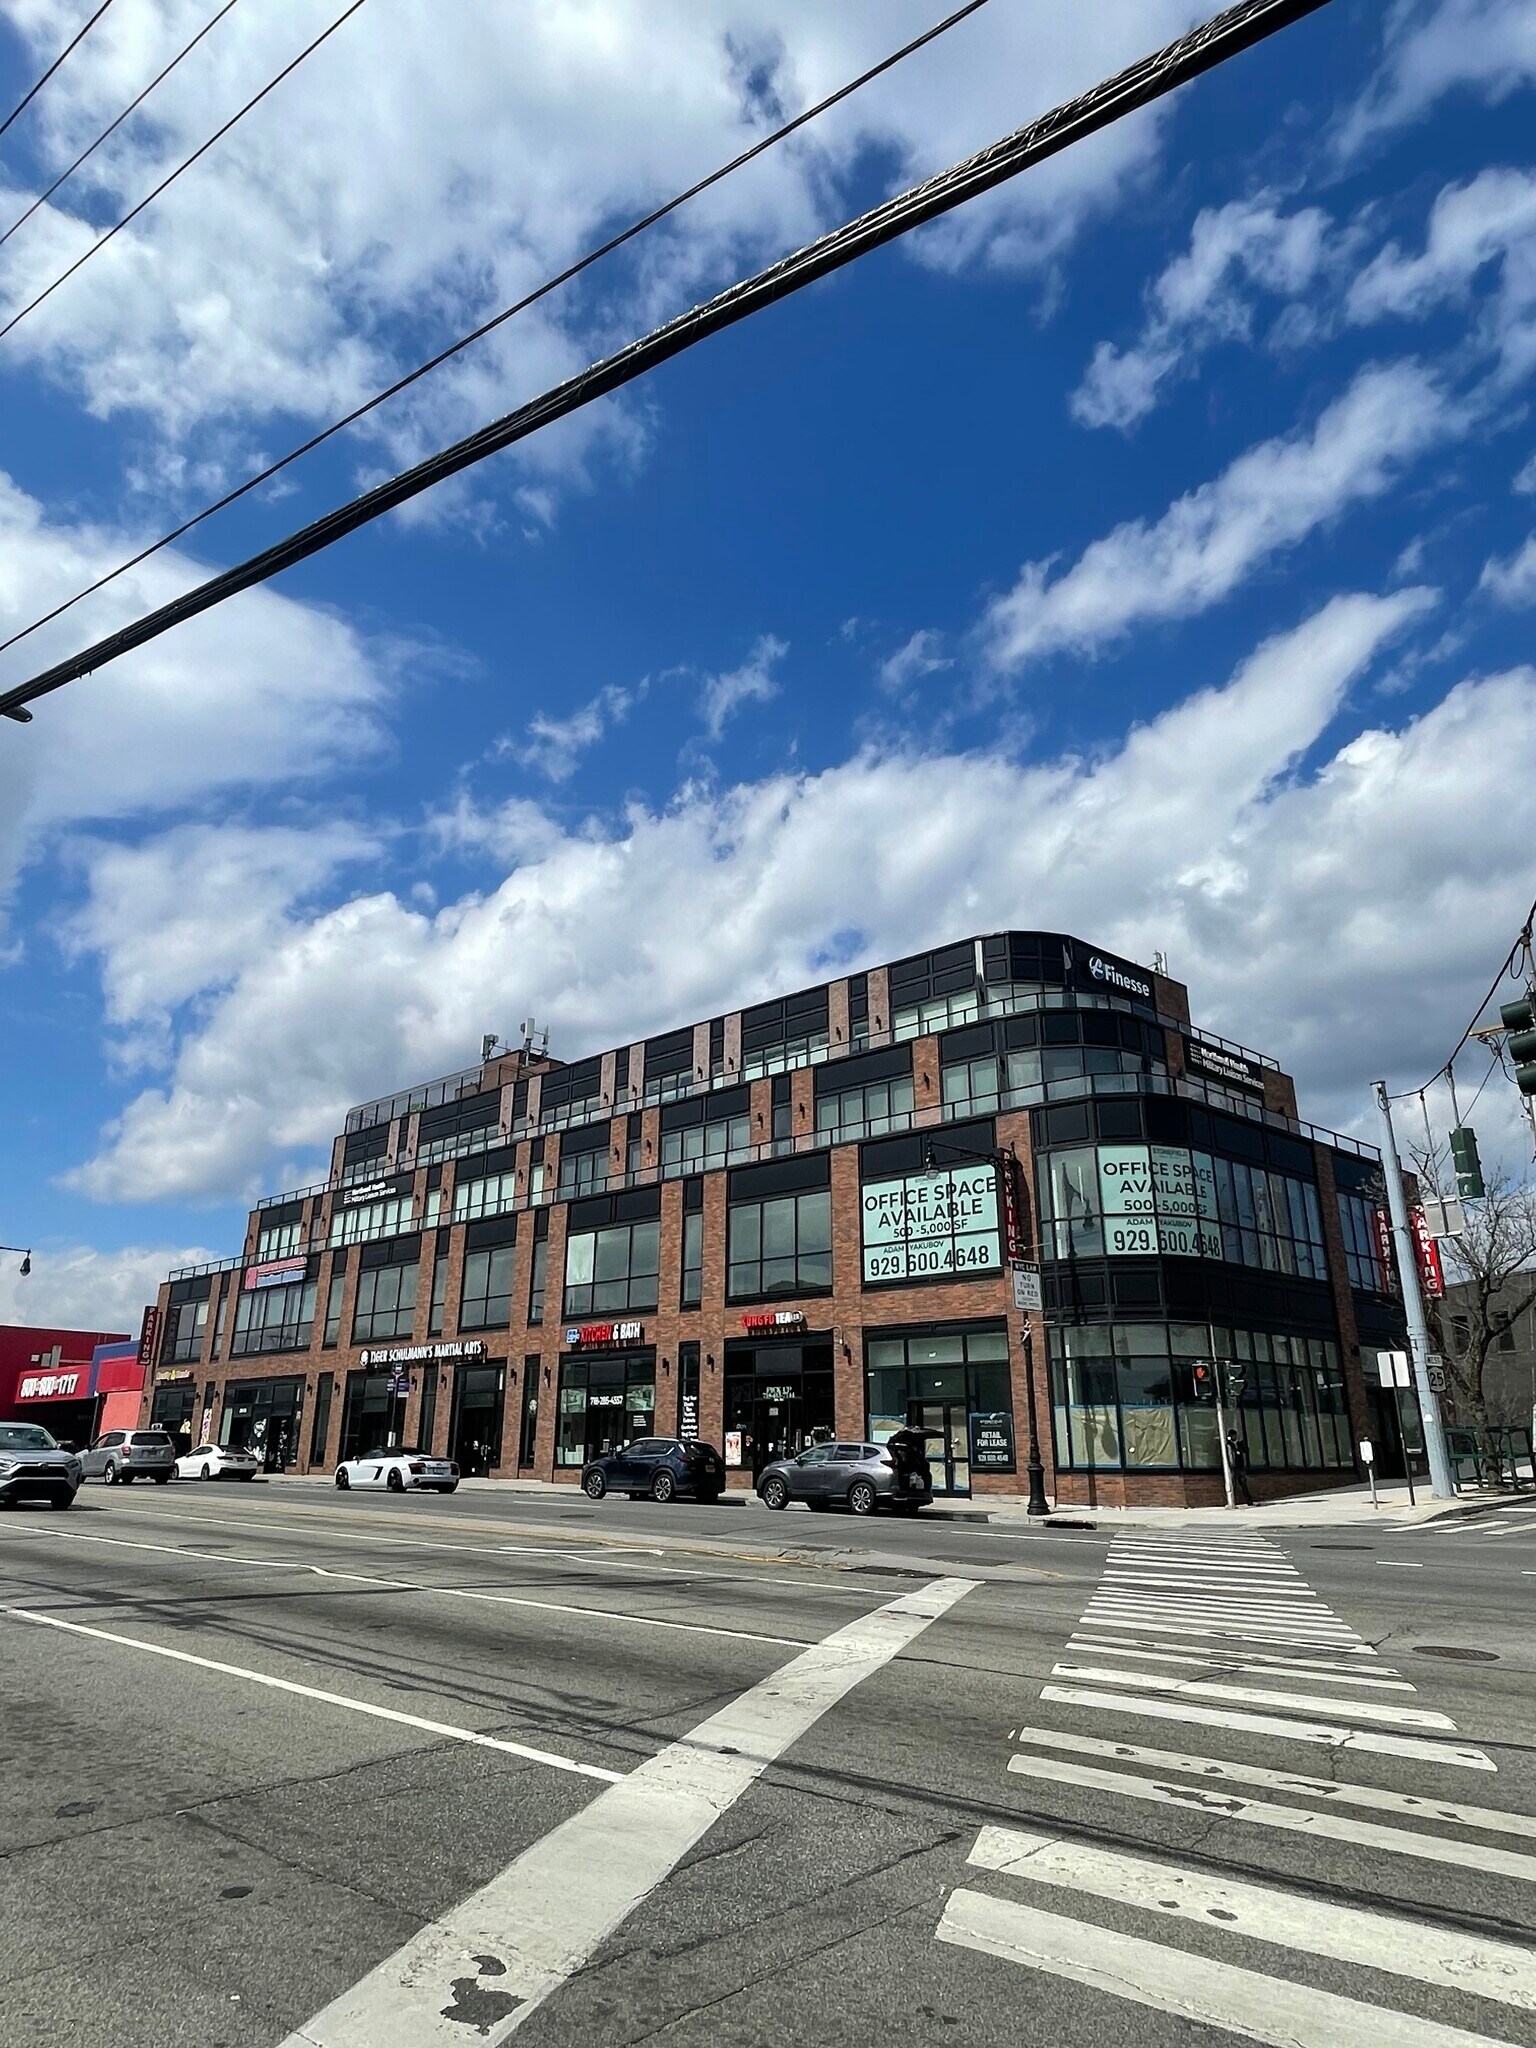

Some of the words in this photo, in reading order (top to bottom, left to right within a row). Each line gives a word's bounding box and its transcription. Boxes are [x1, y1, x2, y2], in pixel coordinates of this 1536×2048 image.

[1104, 964, 1150, 997] Finesse
[1203, 1058, 1222, 1076] Military
[1223, 1067, 1243, 1081] Liaison
[1242, 1074, 1265, 1090] Services
[1103, 1162, 1170, 1176] OFFICE
[1172, 1164, 1213, 1183] SPACE
[864, 1187, 928, 1211] OFFICE
[933, 1176, 997, 1201] SPACE
[1120, 1179, 1207, 1199] AVAILABLE
[878, 1198, 983, 1229] AVAILABLE
[1124, 1199, 1153, 1211] 500
[893, 1226, 913, 1239] 500
[954, 1218, 968, 1230] SF
[1126, 1218, 1153, 1226] ADAM
[883, 1245, 905, 1255] ADAM
[909, 1240, 945, 1251] YAKUBOV
[1113, 1229, 1219, 1257] 929.600.4648
[870, 1245, 989, 1277] 929.600.4648
[1014, 1262, 1026, 1271] NYC
[1019, 1281, 1035, 1290] TURN
[1022, 1274, 1032, 1282] NO
[1016, 1288, 1025, 1296] ON
[1027, 1289, 1039, 1298] RED
[775, 1311, 792, 1325] TEA
[142, 1307, 156, 1359] PARKING
[581, 1324, 612, 1343] KITCHEN
[612, 1323, 619, 1341] &
[620, 1321, 641, 1340] BATH
[370, 1350, 388, 1364] TIGER
[388, 1344, 433, 1362] SCHULMANN'S
[434, 1341, 463, 1358] MARTIAL
[464, 1340, 482, 1355] ARTS
[1430, 1371, 1444, 1387] 25
[976, 1438, 989, 1447] FOR
[989, 1438, 1008, 1447] LEASE
[981, 1431, 1002, 1439] RETAIL
